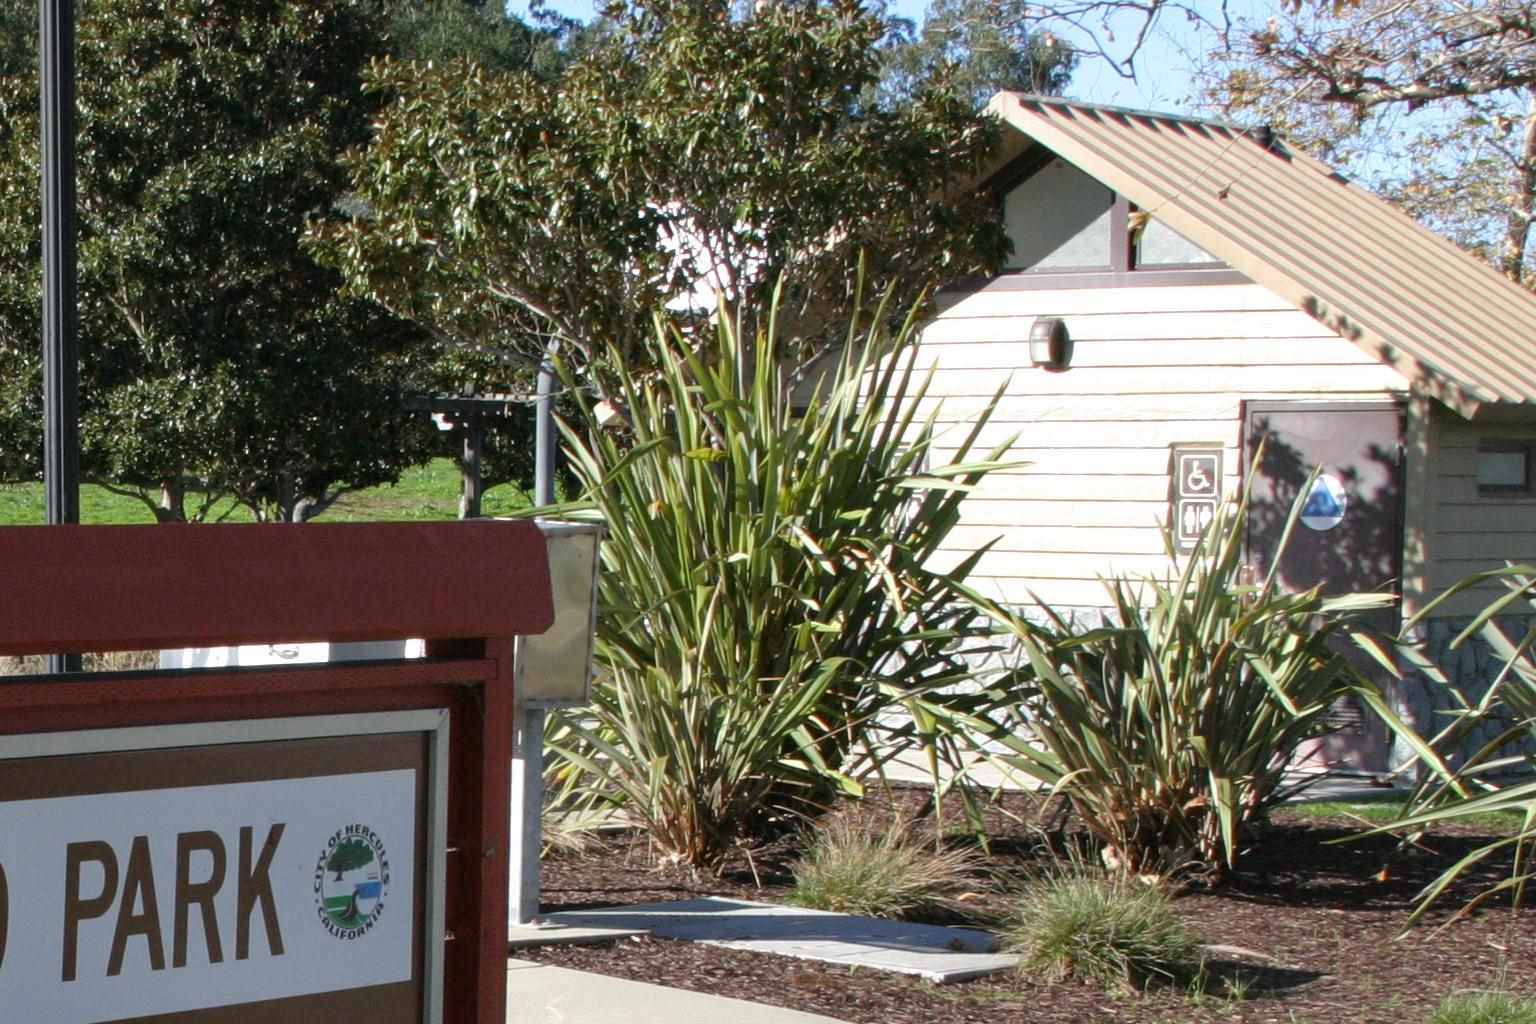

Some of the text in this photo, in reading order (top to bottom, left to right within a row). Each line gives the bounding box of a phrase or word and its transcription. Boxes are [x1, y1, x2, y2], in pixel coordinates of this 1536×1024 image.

[313, 824, 390, 894] CITY OF HERCULES
[62, 823, 286, 983] PARK
[317, 902, 385, 941] CALIFORNIA
